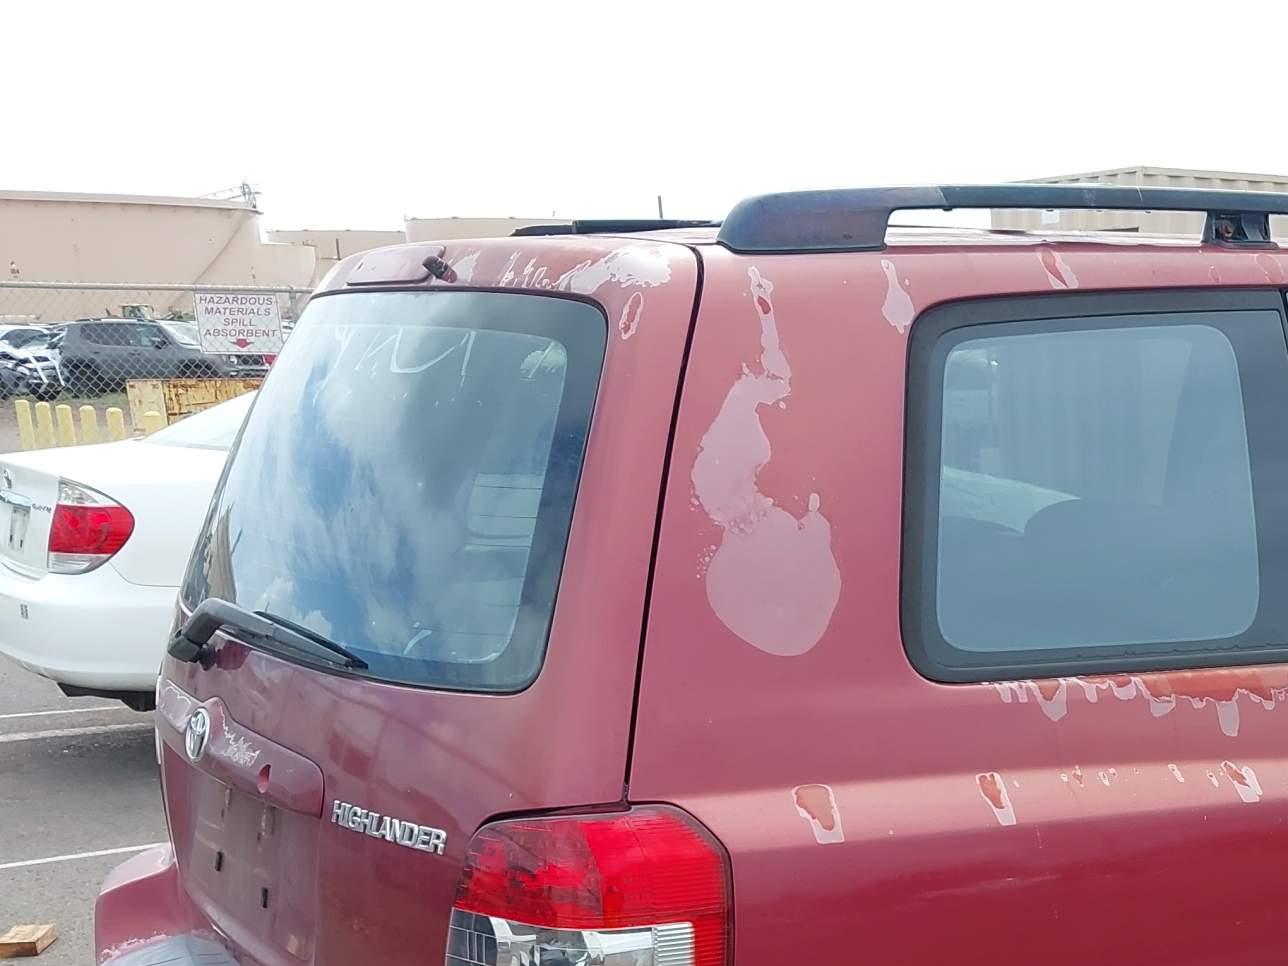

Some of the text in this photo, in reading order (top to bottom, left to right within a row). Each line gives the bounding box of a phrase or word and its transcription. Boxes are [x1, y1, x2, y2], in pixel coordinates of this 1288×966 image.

[199, 296, 273, 306] HAZARDOUS
[204, 307, 271, 316] MATERIALS
[223, 318, 256, 327] SPILL
[204, 329, 277, 337] ABSORBENT
[331, 799, 448, 856] HIGHLANDER
